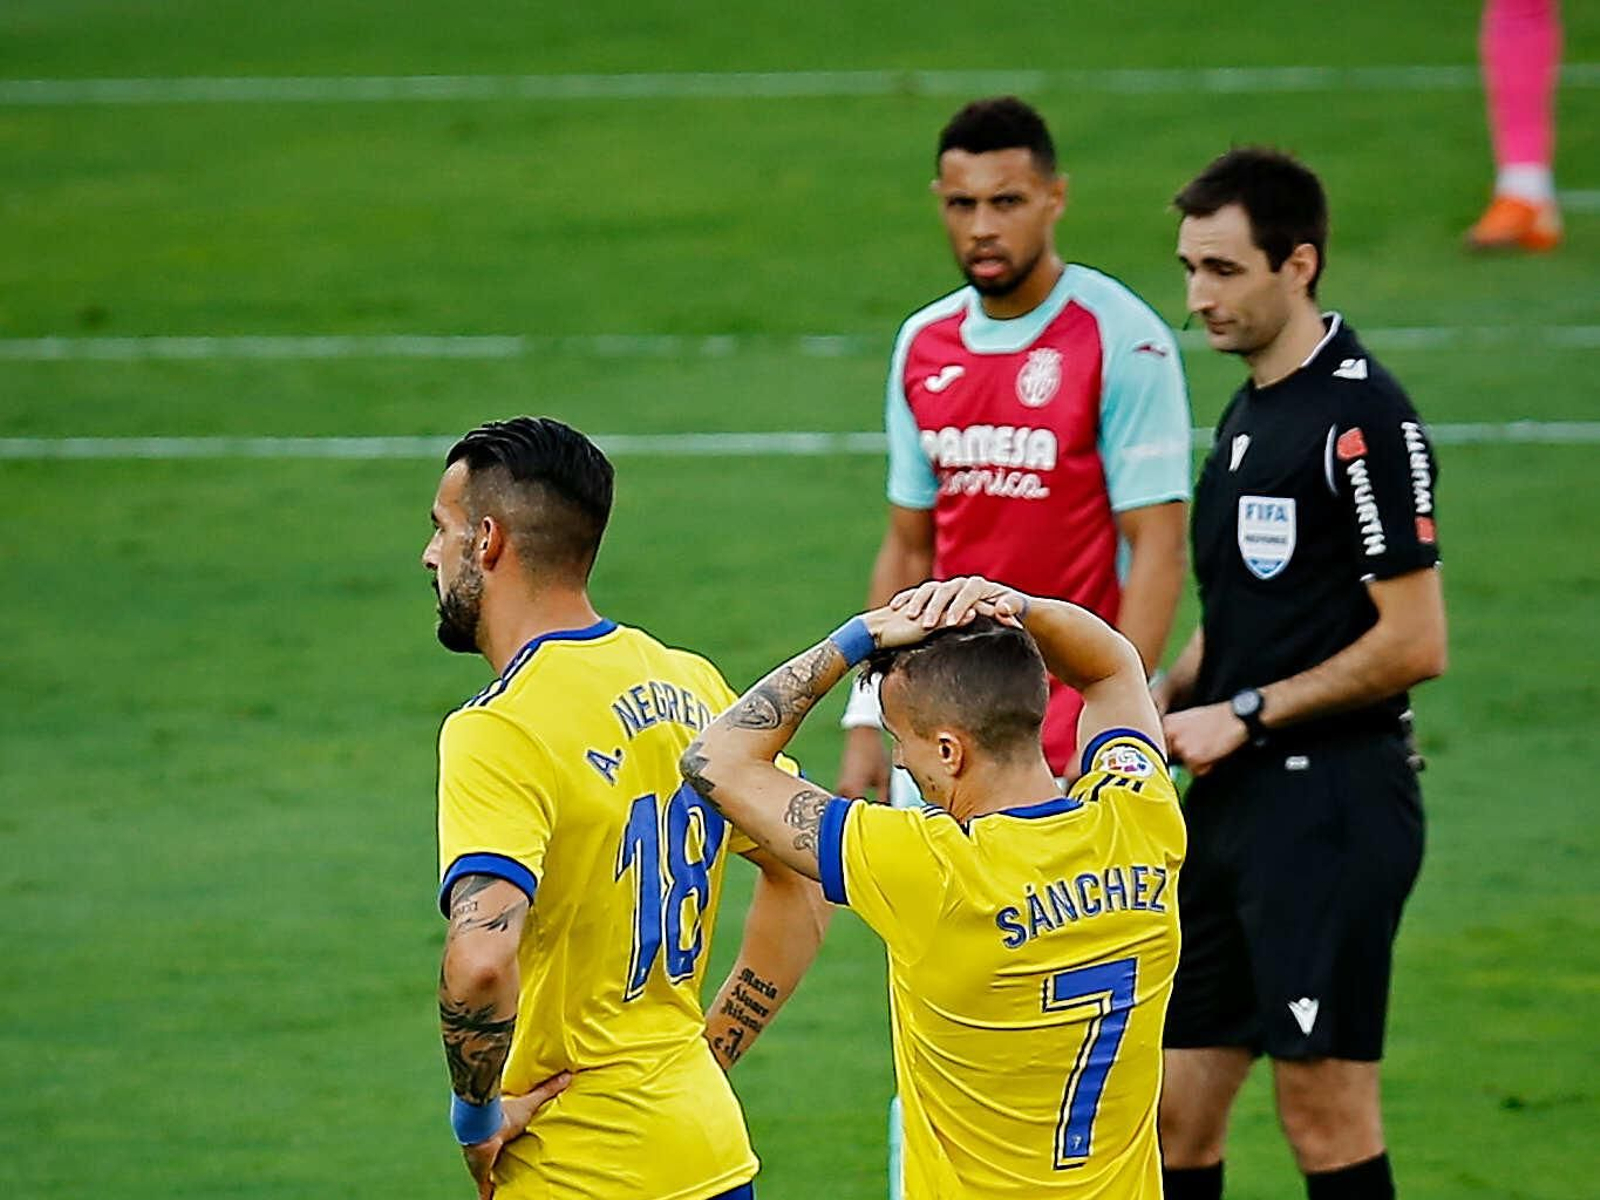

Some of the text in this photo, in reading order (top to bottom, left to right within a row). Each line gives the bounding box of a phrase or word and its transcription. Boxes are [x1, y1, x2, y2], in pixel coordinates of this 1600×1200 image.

[1246, 503, 1288, 521] FIFA
[587, 681, 714, 787] A. NEGRED
[615, 778, 733, 1002] 18
[996, 866, 1167, 948] SÁNCHEZ
[1042, 957, 1139, 1170] 7
